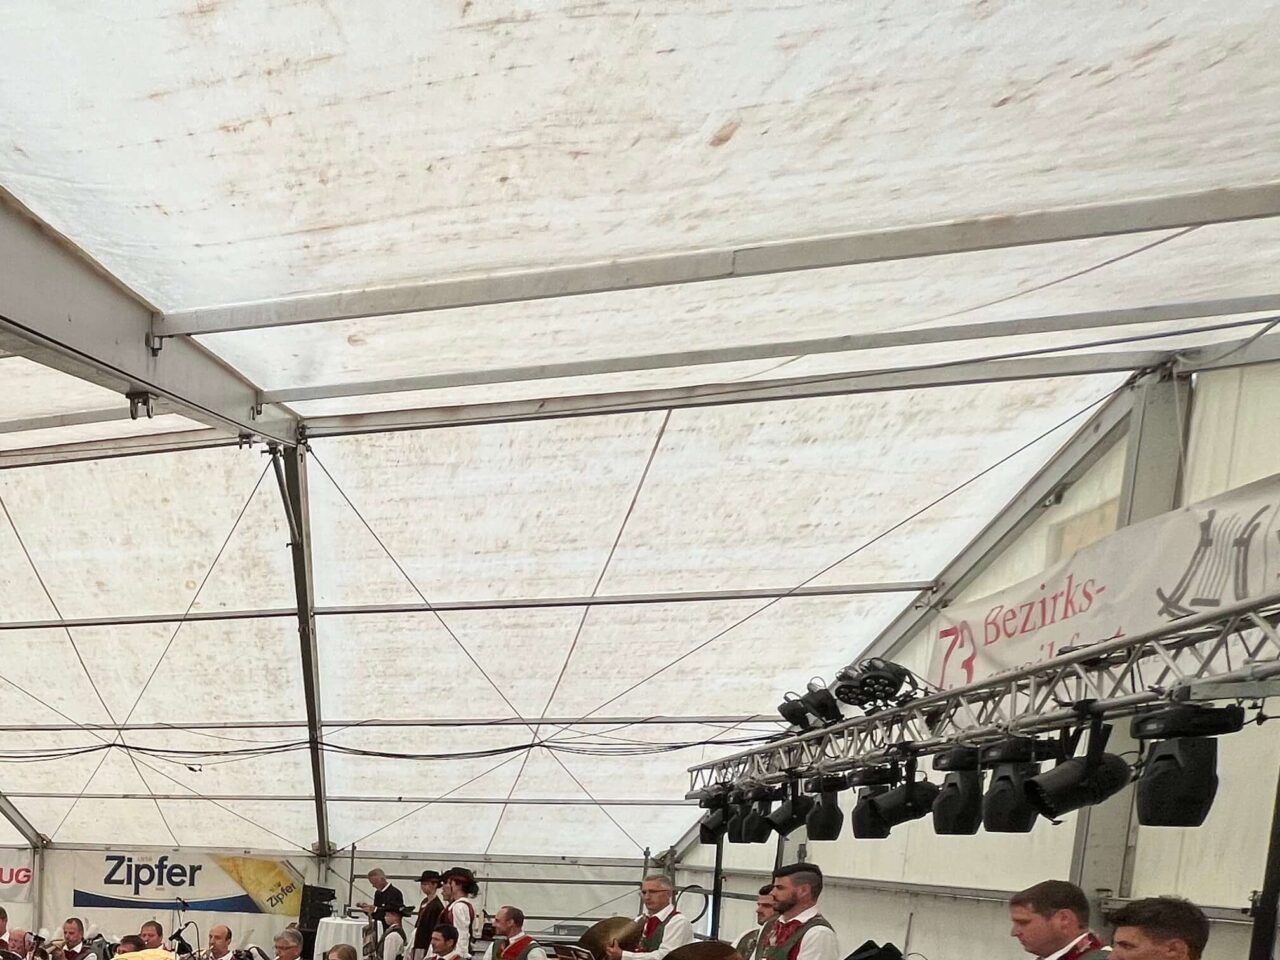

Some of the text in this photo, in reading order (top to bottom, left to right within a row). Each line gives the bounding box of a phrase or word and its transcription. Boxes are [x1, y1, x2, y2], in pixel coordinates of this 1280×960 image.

[984, 573, 1107, 646] Bezirks-
[103, 855, 202, 896] Zipfer
[266, 883, 297, 908] Zipfer
